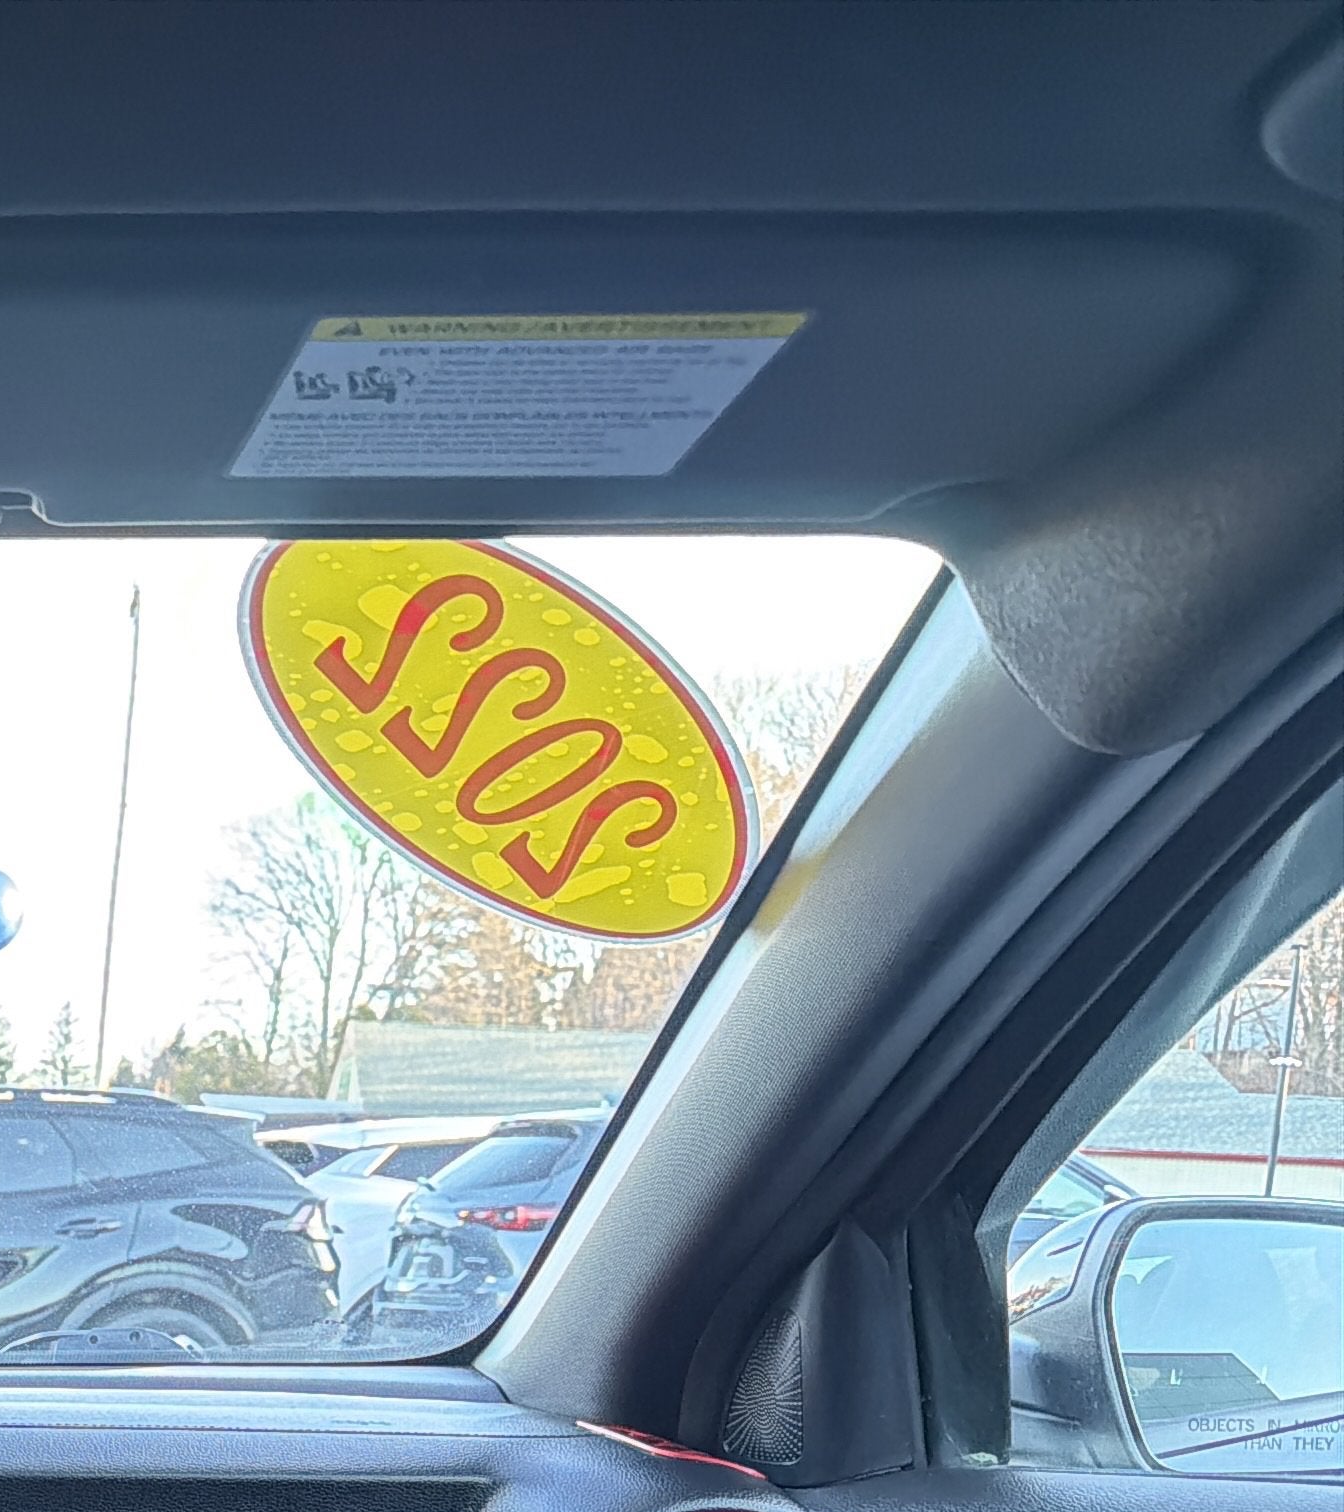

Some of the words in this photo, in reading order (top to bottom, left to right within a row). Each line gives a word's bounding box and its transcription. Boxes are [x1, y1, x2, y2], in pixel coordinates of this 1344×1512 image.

[1188, 1417, 1255, 1433] OBJECTS
[1267, 1418, 1281, 1432] IN
[1243, 1436, 1283, 1451] THAN
[1292, 1436, 1335, 1451] THEY
